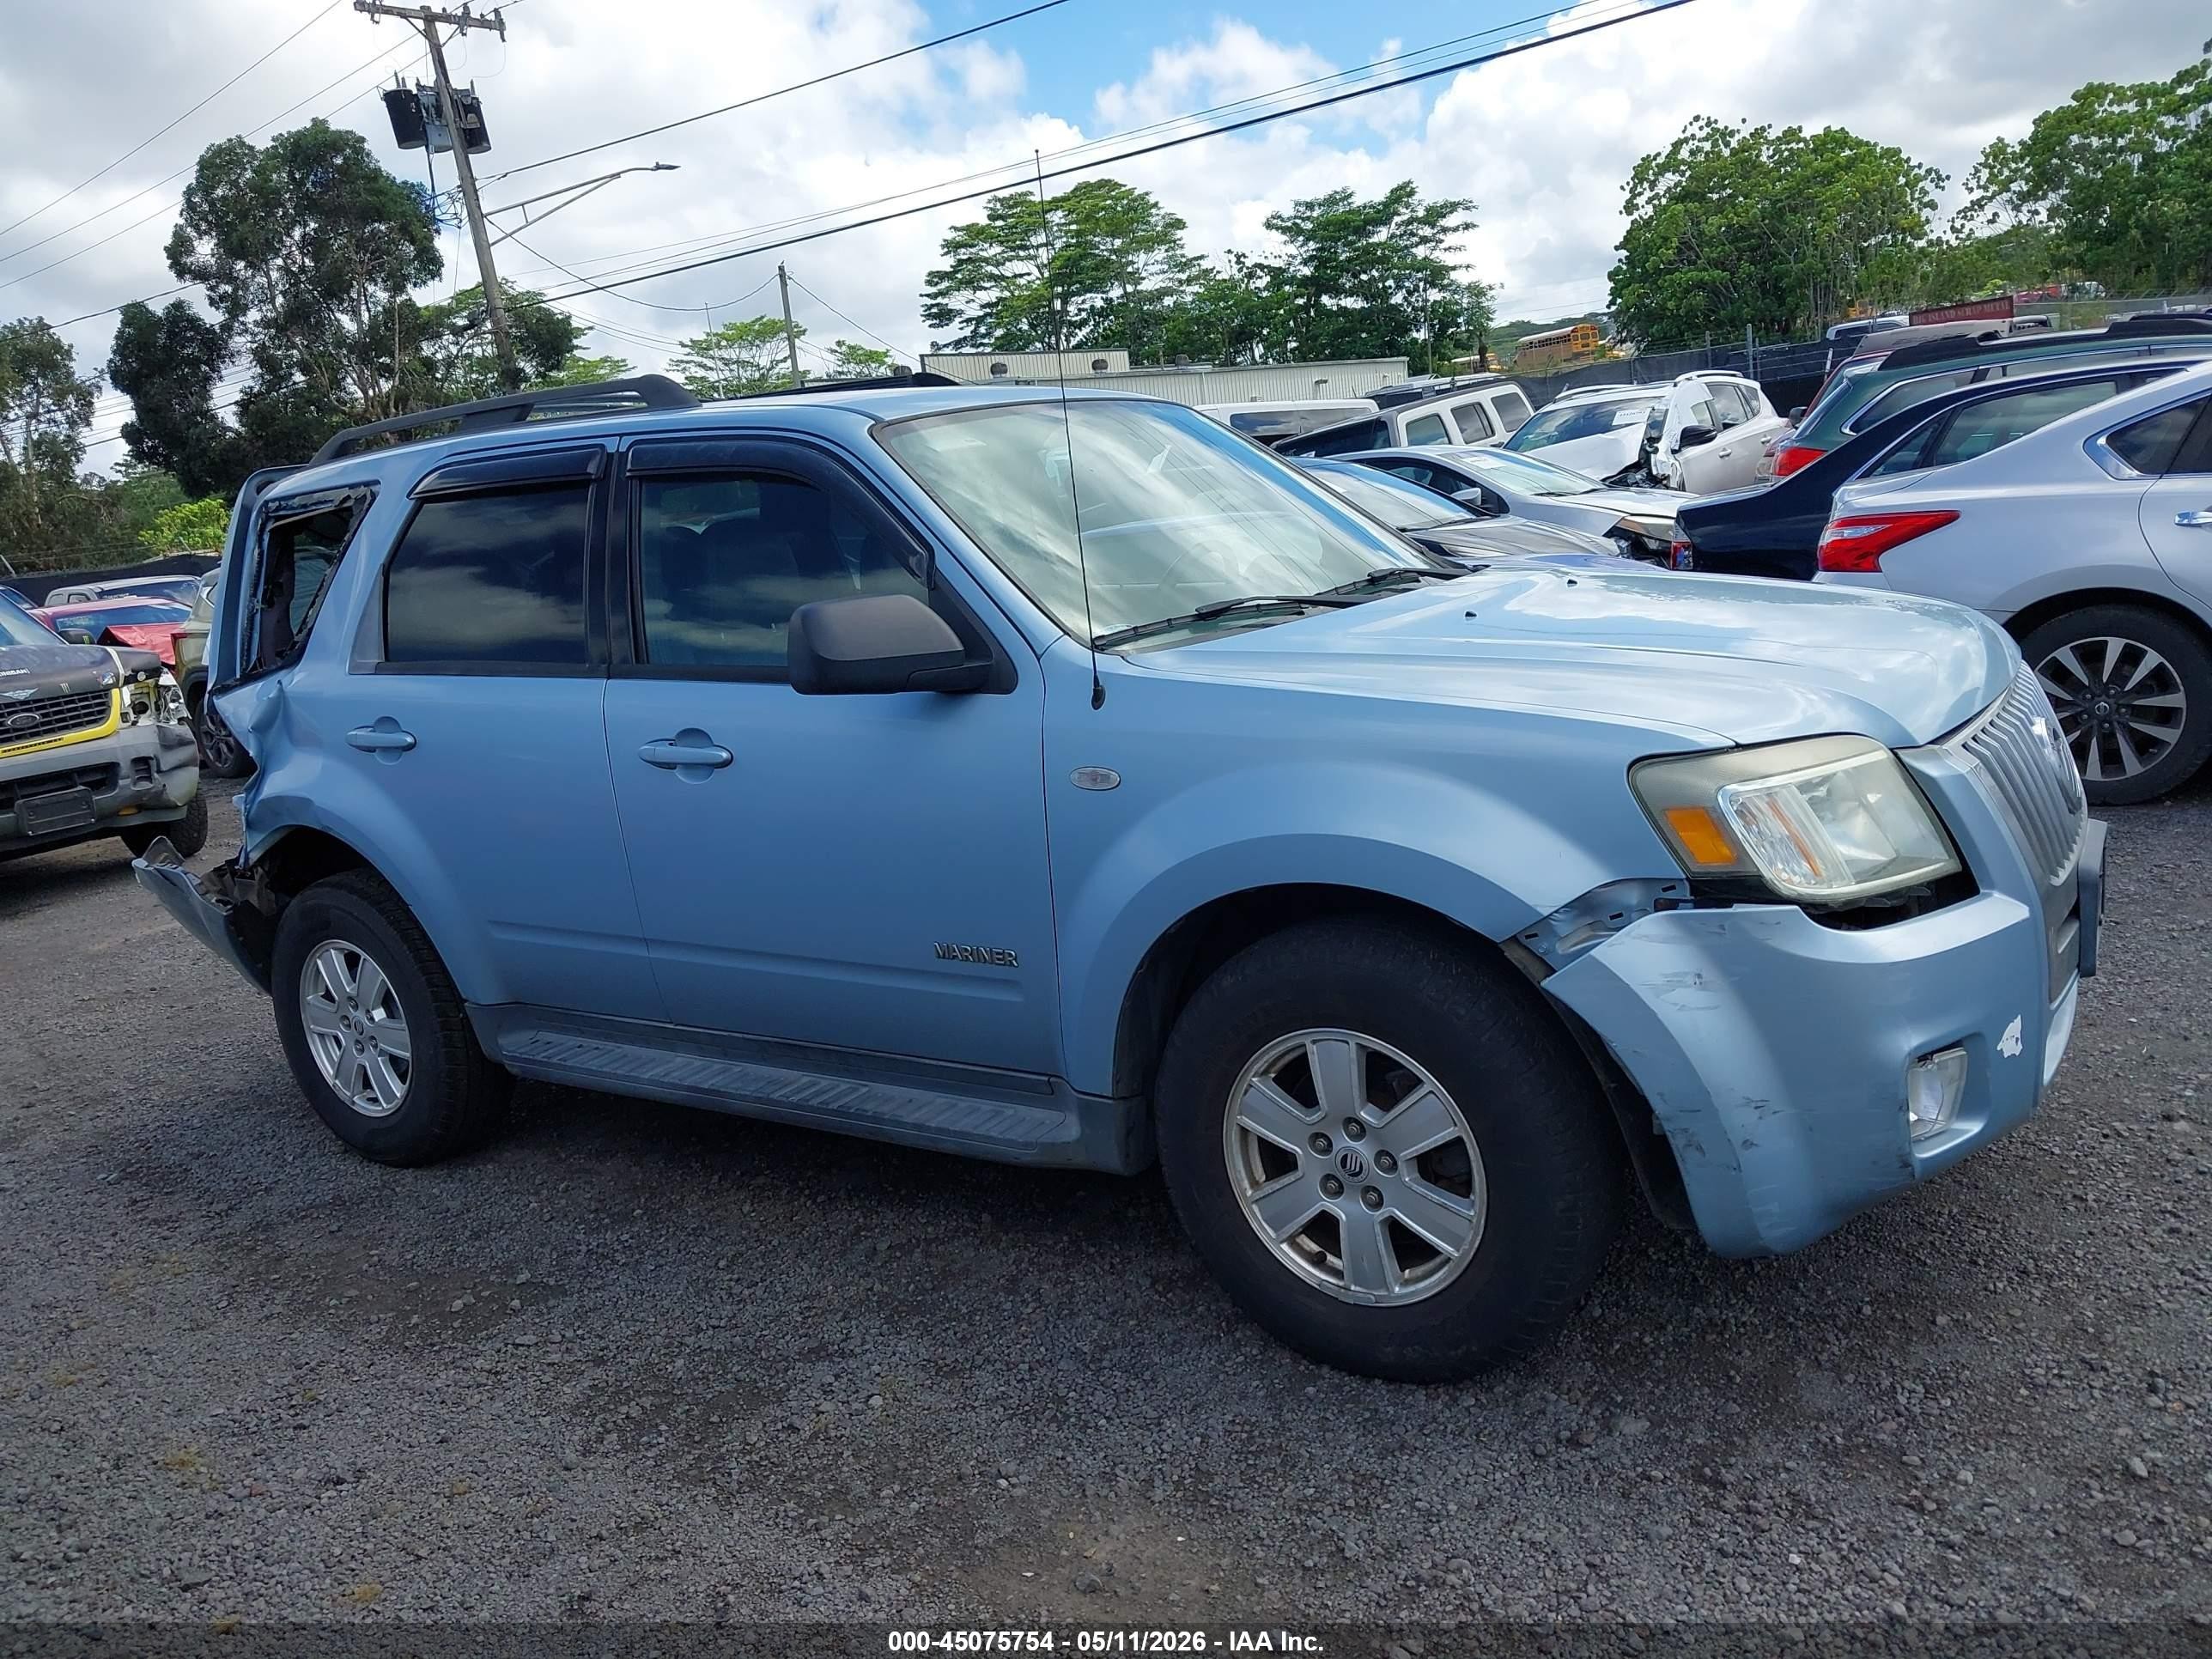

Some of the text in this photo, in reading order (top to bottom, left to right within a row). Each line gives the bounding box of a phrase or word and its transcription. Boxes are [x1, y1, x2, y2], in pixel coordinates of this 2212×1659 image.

[1928, 309, 1956, 322] ISLAND
[1957, 306, 1983, 317] SCRAP
[1984, 301, 2010, 313] METAL
[933, 941, 1019, 968] MARINER
